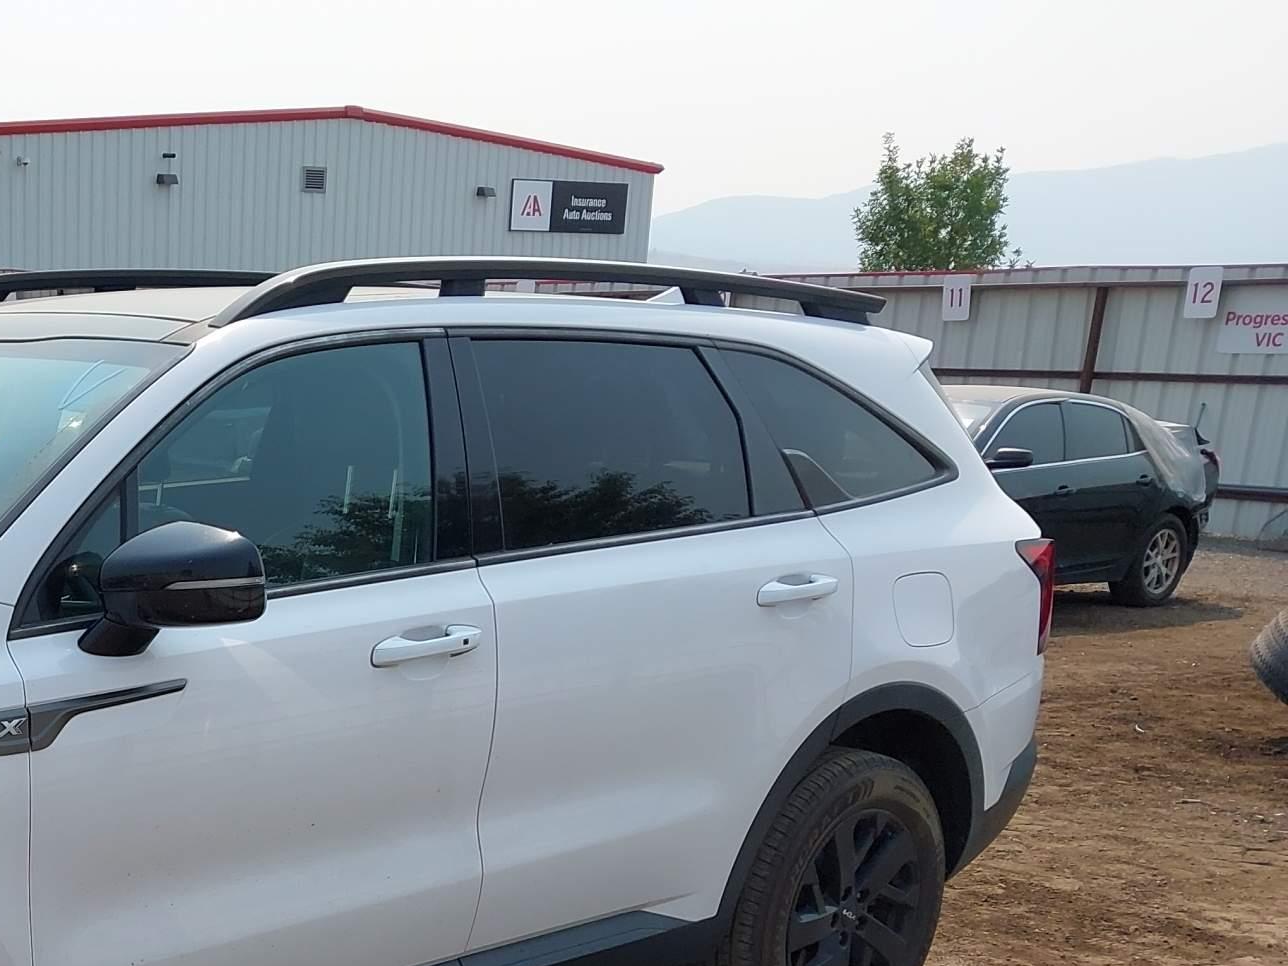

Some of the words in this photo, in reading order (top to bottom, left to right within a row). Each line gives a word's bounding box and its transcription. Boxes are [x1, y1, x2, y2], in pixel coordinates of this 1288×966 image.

[571, 195, 607, 207] Insurance
[562, 208, 580, 220] Auto
[581, 208, 613, 221] Auctions
[948, 287, 964, 309] 11
[1191, 281, 1215, 304] 12
[1255, 332, 1285, 348] VIC
